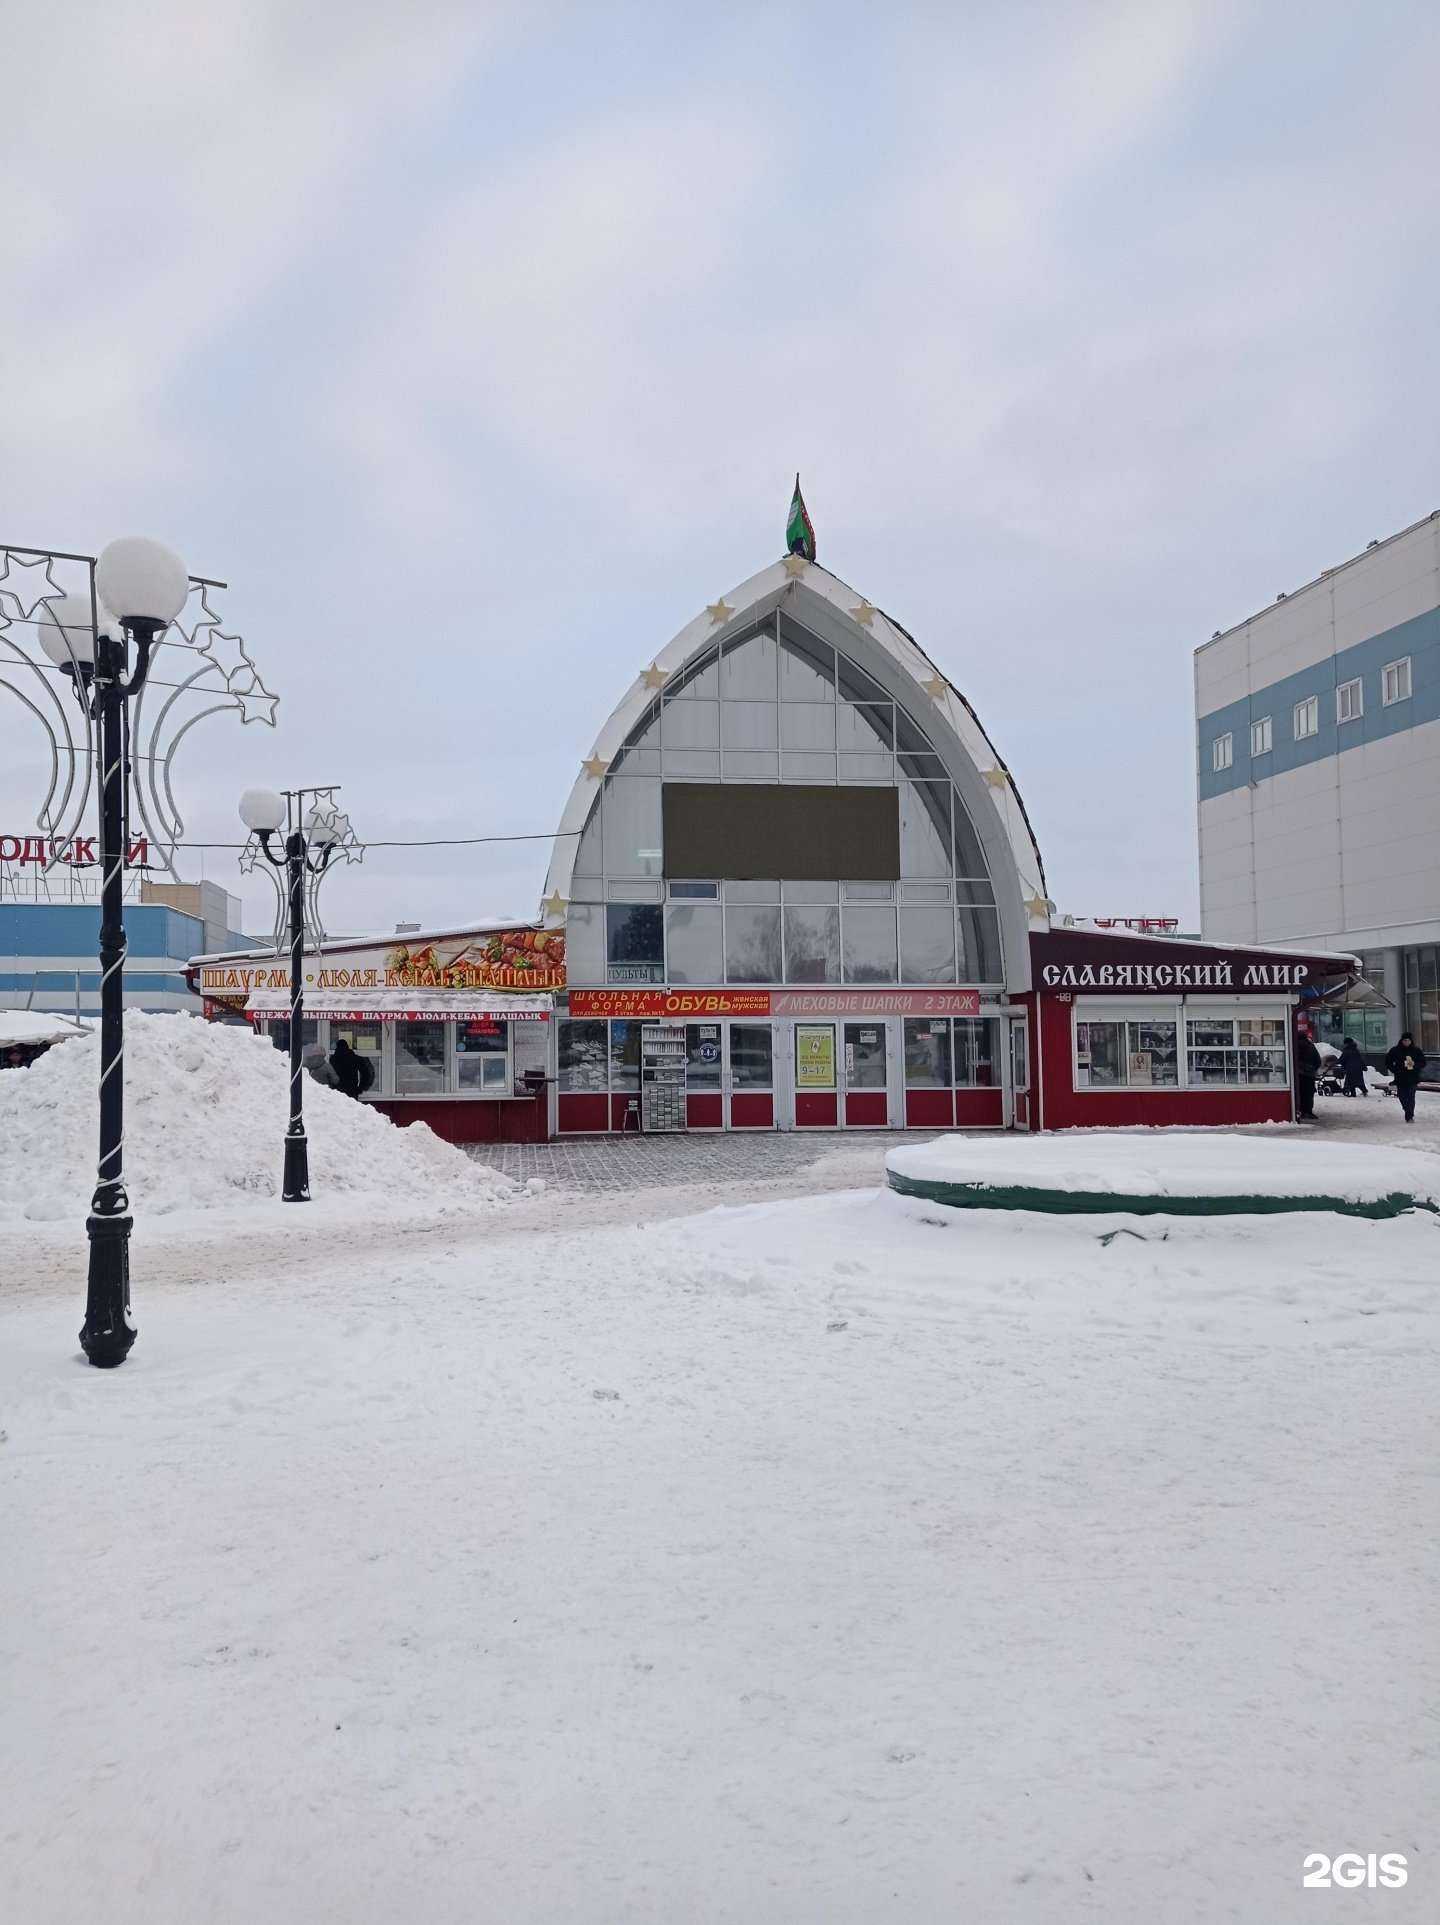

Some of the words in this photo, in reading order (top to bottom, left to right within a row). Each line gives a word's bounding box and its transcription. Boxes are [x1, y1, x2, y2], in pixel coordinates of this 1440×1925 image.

[0, 832, 148, 866] ОДСКЙ
[1042, 960, 1233, 986] СЛАВЯНСКИЙ
[1243, 965, 1309, 985] МИР
[203, 969, 293, 993] ШАУРМ
[317, 968, 451, 988] ЛЮЛЯ-КЕБАБ
[465, 969, 563, 987] ШАШЛЫК
[574, 992, 662, 1000] ШКОЛЬНАЯ
[790, 996, 857, 1010] МЕХОВЫЕ
[862, 996, 912, 1010] ШАПКИ
[925, 996, 932, 1009] 2
[938, 996, 975, 1009] ЭТАЖ
[591, 1001, 646, 1010] ФОРМА
[666, 996, 731, 1011] ОБУВЬ
[303, 1011, 356, 1020] ВЫПЕЧКА
[362, 1012, 408, 1020] ШАУРМА
[415, 1012, 484, 1020] ЛЮЛЯ-КЕБАБ
[490, 1012, 542, 1020] ШАШЛЫК
